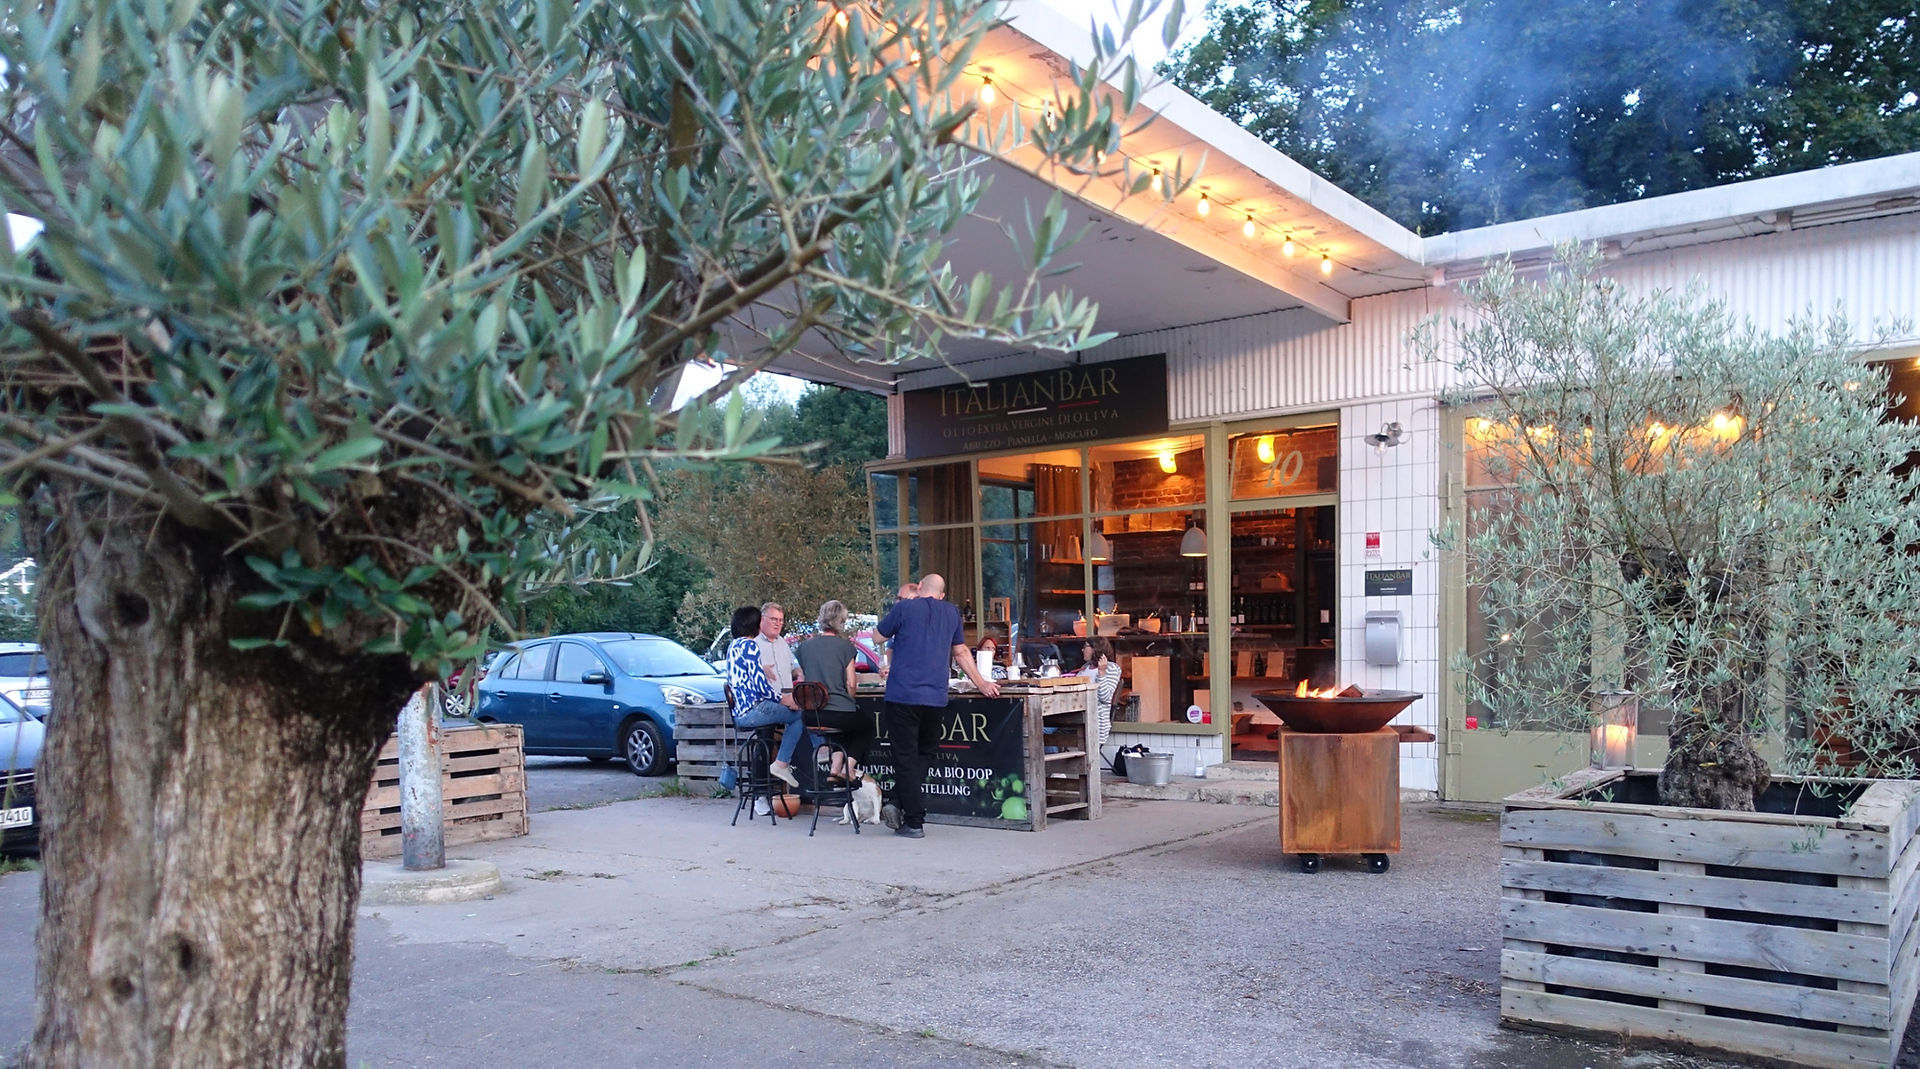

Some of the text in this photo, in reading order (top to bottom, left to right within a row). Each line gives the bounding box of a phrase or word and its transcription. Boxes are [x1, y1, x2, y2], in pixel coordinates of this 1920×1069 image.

[941, 367, 1120, 416] ITALIANBAR
[978, 423, 1009, 434] EXTRA
[1011, 415, 1055, 430] VERGINE
[1007, 434, 1048, 447] PIANELLA
[1262, 450, 1304, 488] 10
[944, 766, 965, 779] BIO
[967, 768, 993, 780] DOP
